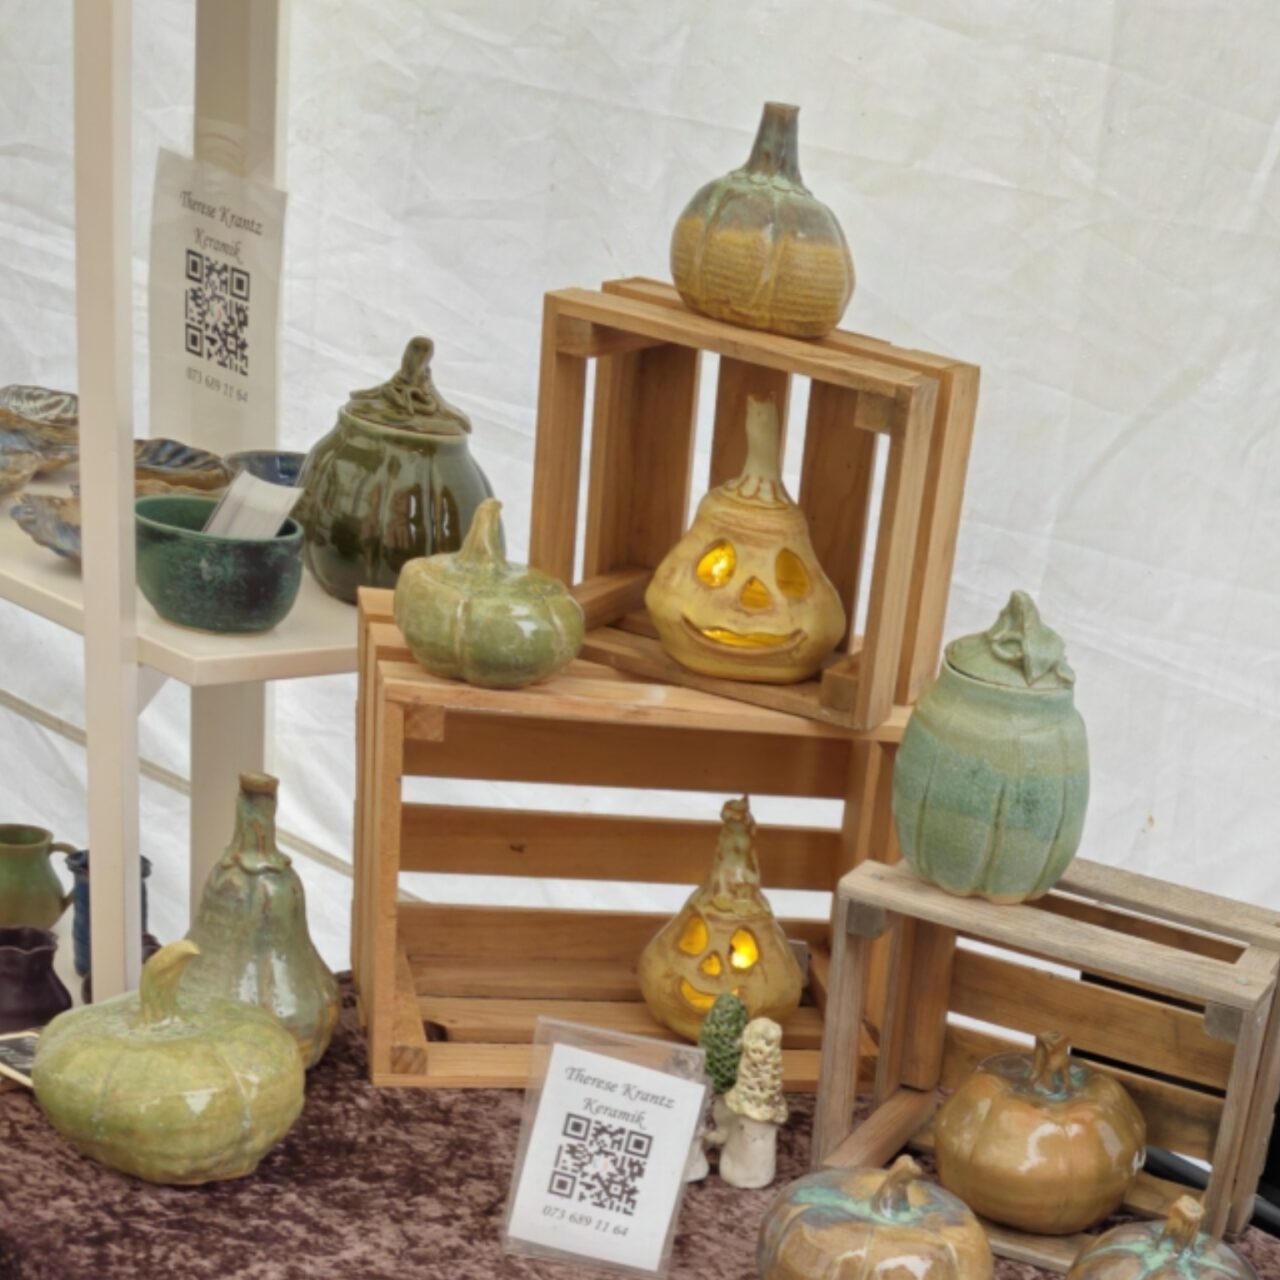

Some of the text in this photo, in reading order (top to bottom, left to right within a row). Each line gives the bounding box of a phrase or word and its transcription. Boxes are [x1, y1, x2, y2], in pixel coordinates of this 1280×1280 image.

[180, 190, 216, 219] Therese
[564, 1066, 676, 1109] Therese Krantz
[583, 1097, 647, 1130] Keramik
[542, 1205, 566, 1220] 073
[612, 1225, 629, 1237] 64
